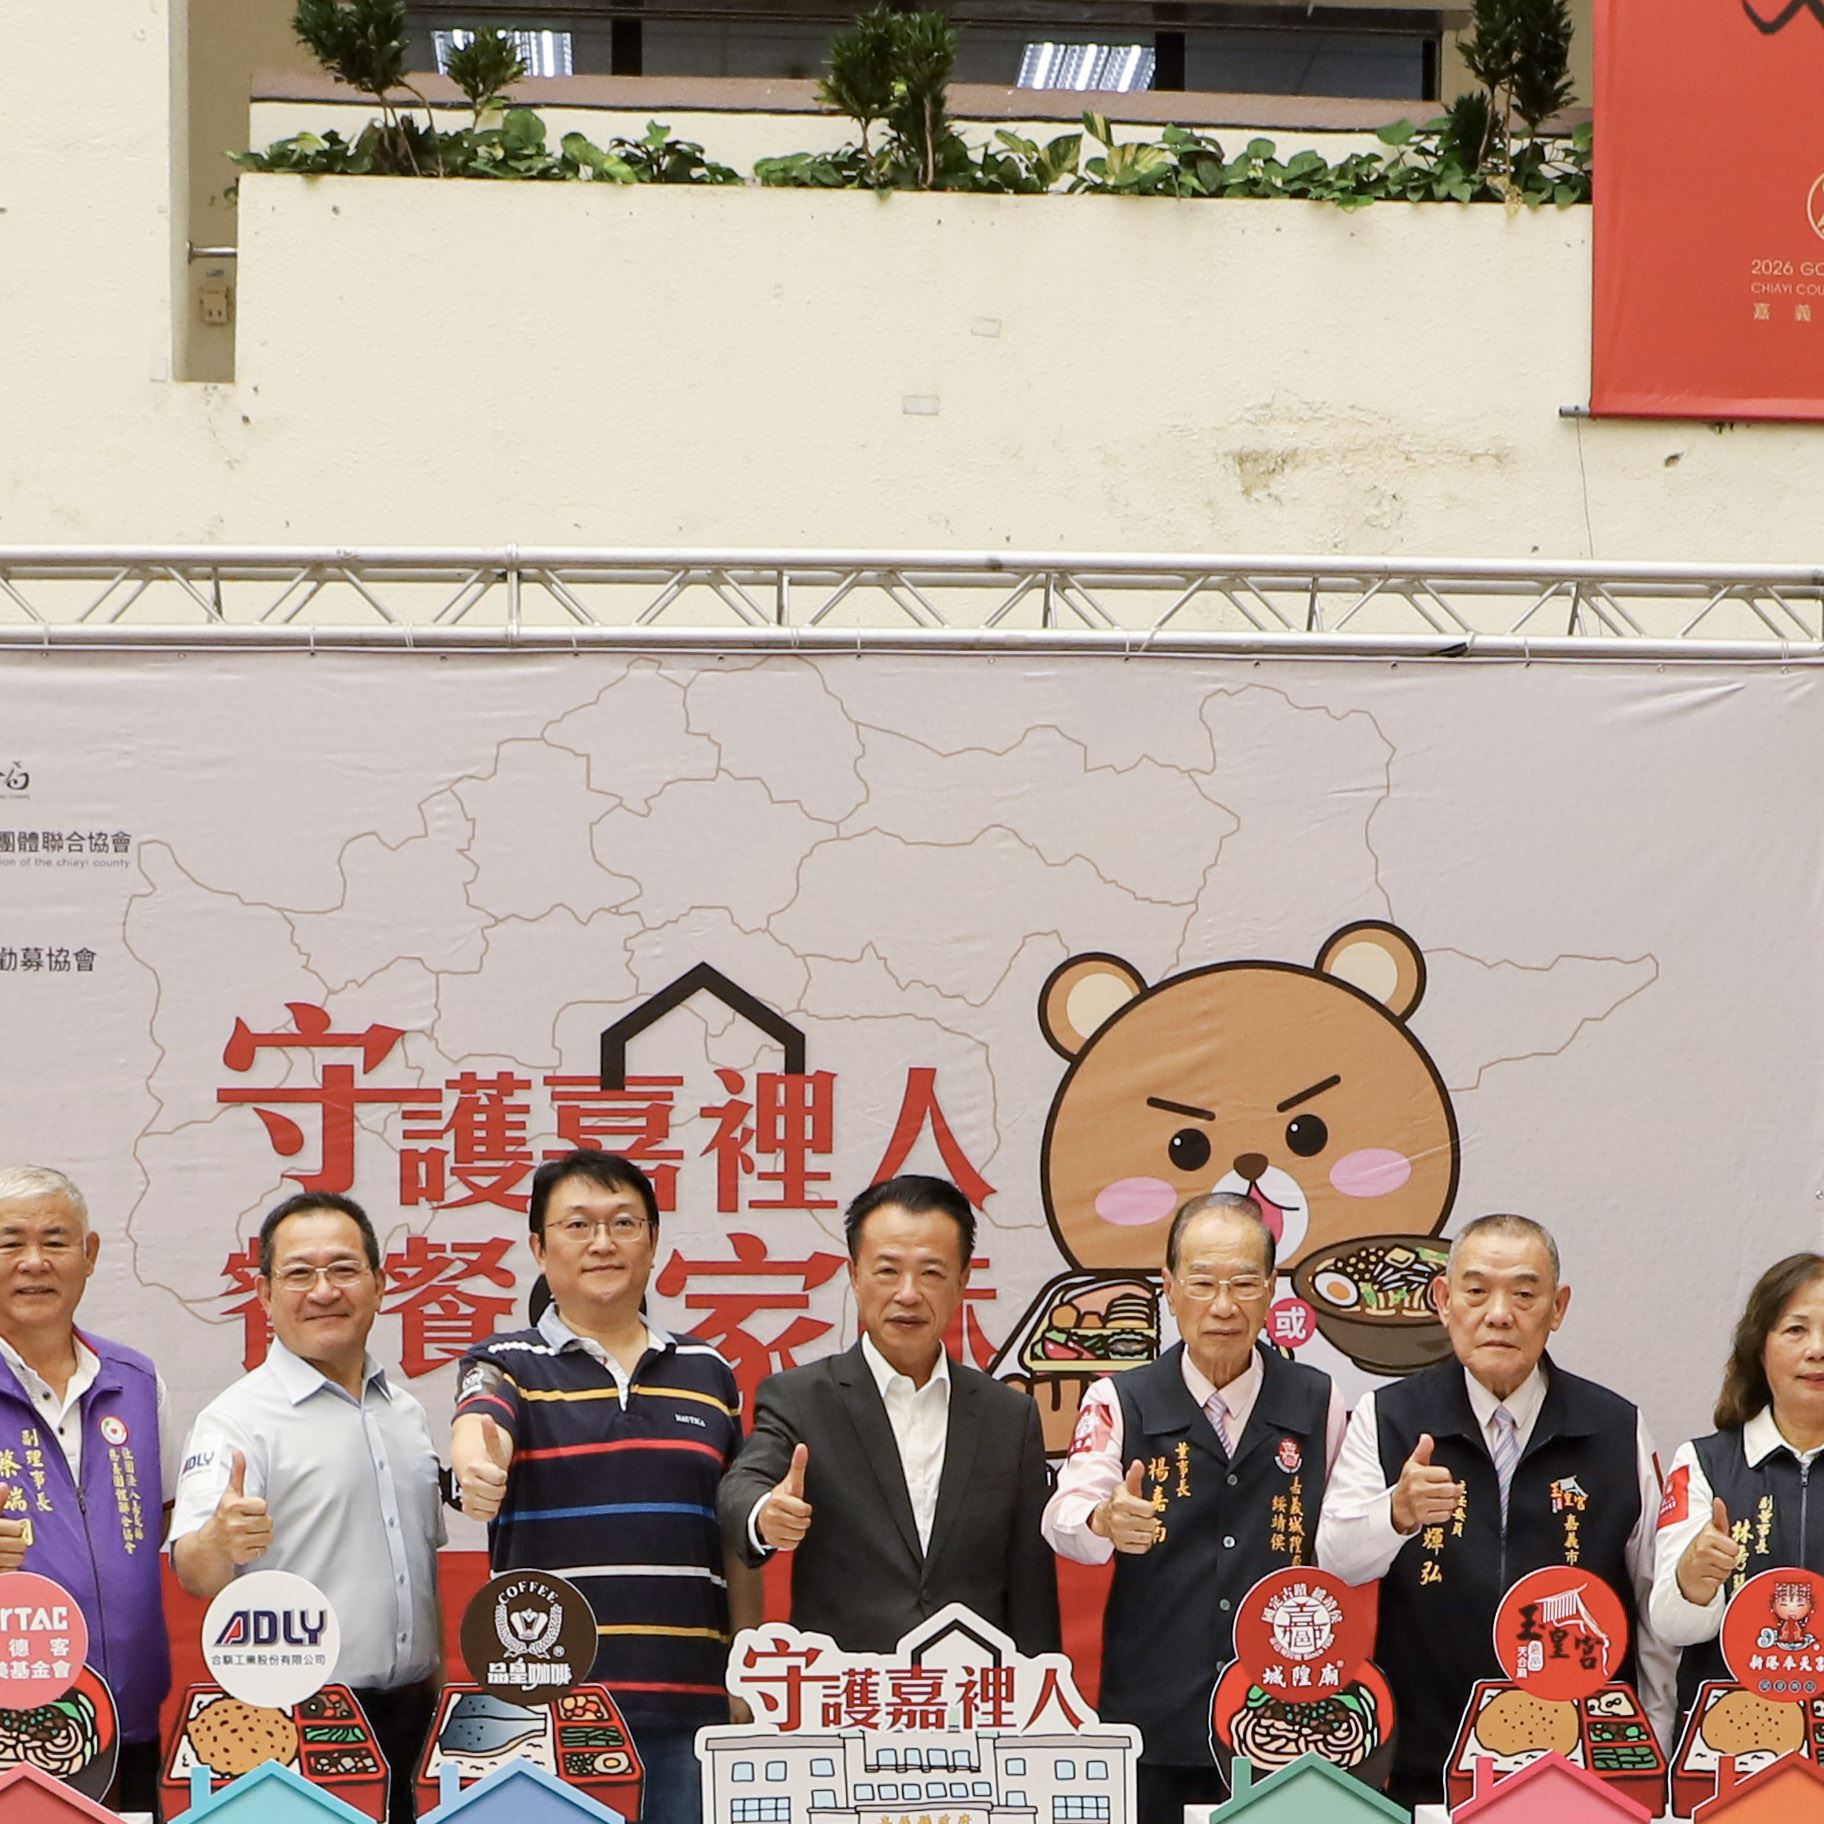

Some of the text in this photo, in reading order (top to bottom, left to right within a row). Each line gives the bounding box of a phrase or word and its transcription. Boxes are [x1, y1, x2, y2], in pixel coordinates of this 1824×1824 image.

[1751, 259, 1794, 275] 2026
[1750, 281, 1793, 295] CHIAYI
[1274, 1307, 1307, 1340] 或
[498, 1581, 559, 1604] COFFEE
[213, 1608, 328, 1647] ADLY
[487, 1657, 573, 1691] 品皇咖啡
[739, 1638, 1086, 1733] 守護嘉裡人
[1262, 1662, 1339, 1688] 城隍廟
